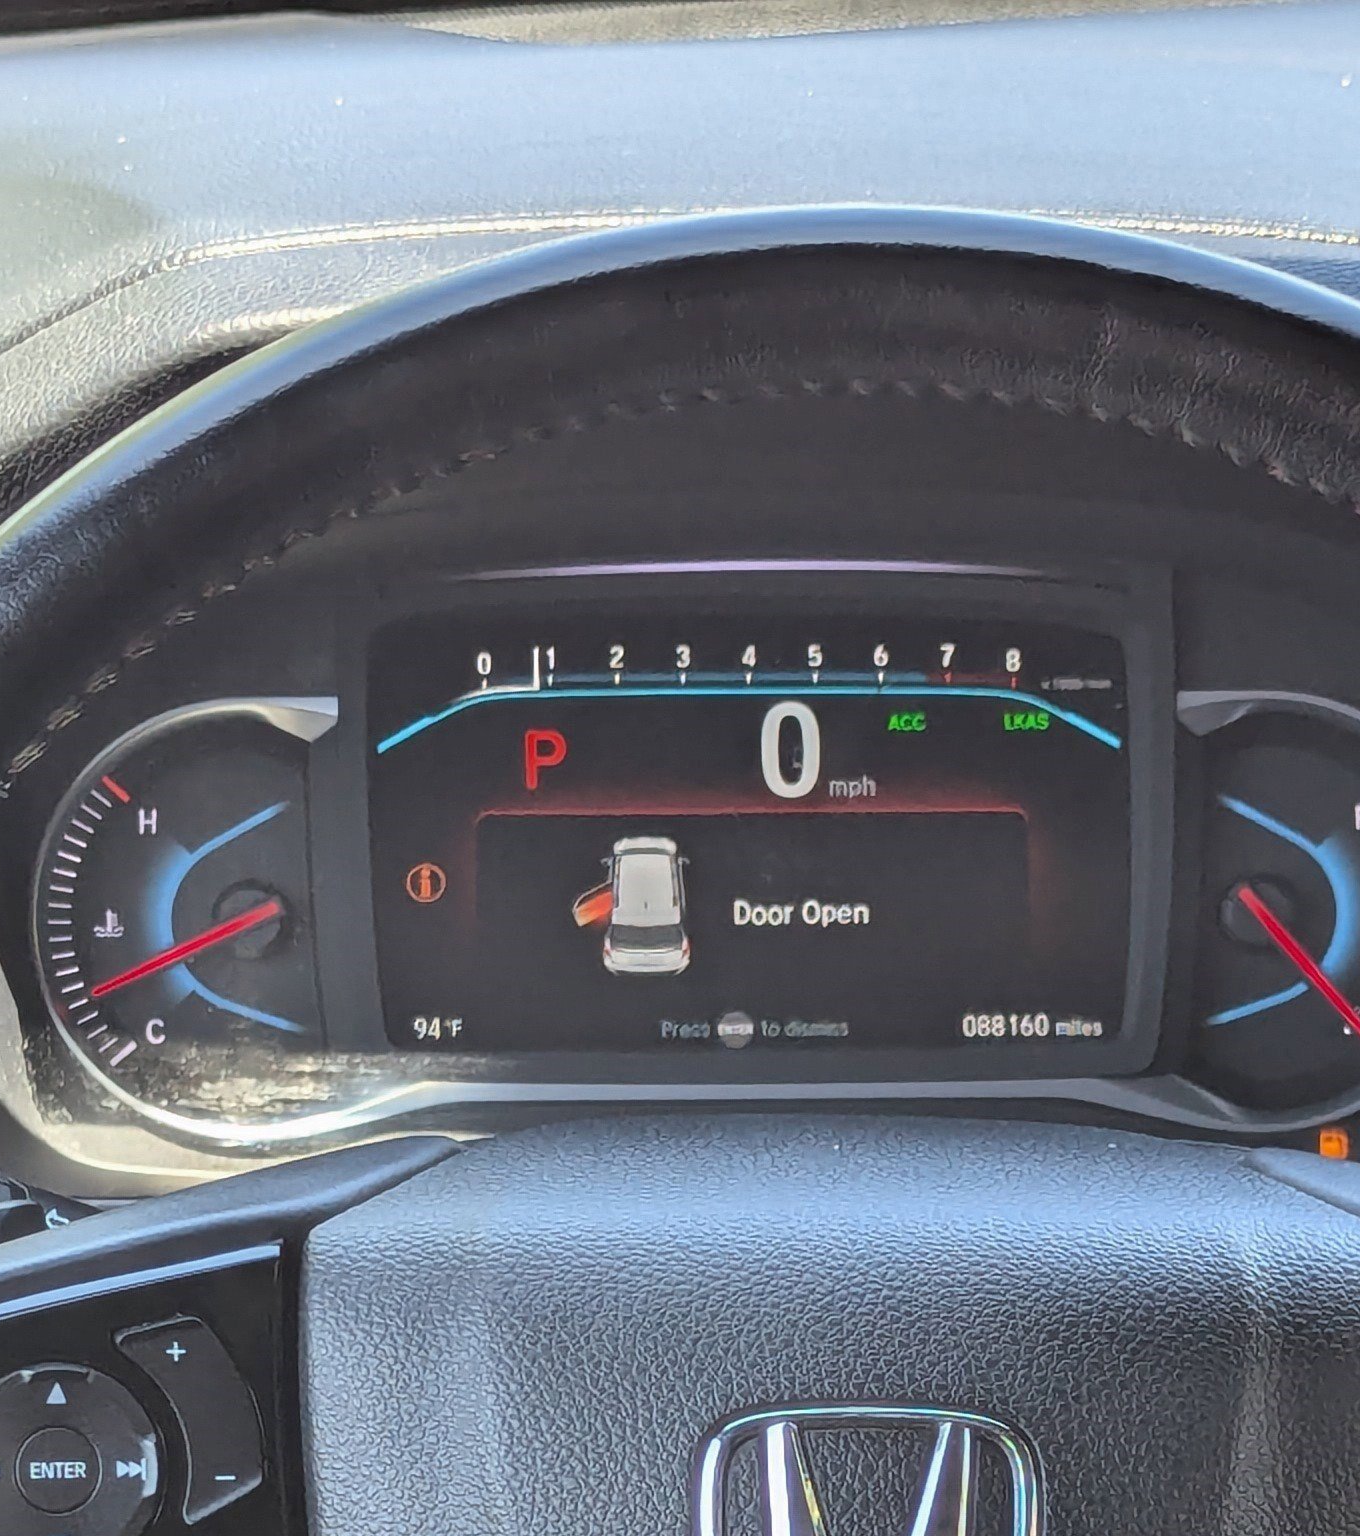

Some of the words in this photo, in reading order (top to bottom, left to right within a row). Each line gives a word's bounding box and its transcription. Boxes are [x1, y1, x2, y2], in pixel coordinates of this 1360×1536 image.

[476, 651, 492, 675] 0
[546, 646, 555, 670] 1
[609, 645, 624, 669] 2
[676, 644, 690, 669] 3
[741, 645, 756, 667] 4
[808, 644, 823, 667] 5
[873, 644, 888, 667] 6
[941, 643, 955, 667] 7
[1006, 648, 1021, 672] 8
[525, 729, 567, 790] P
[761, 701, 821, 798] 0
[829, 775, 877, 798] mph
[139, 808, 158, 835] H
[734, 900, 794, 926] Door
[802, 900, 870, 928] Open
[146, 1019, 166, 1045] C
[963, 1014, 1050, 1038] 088160
[30, 1461, 87, 1480] ENTER
